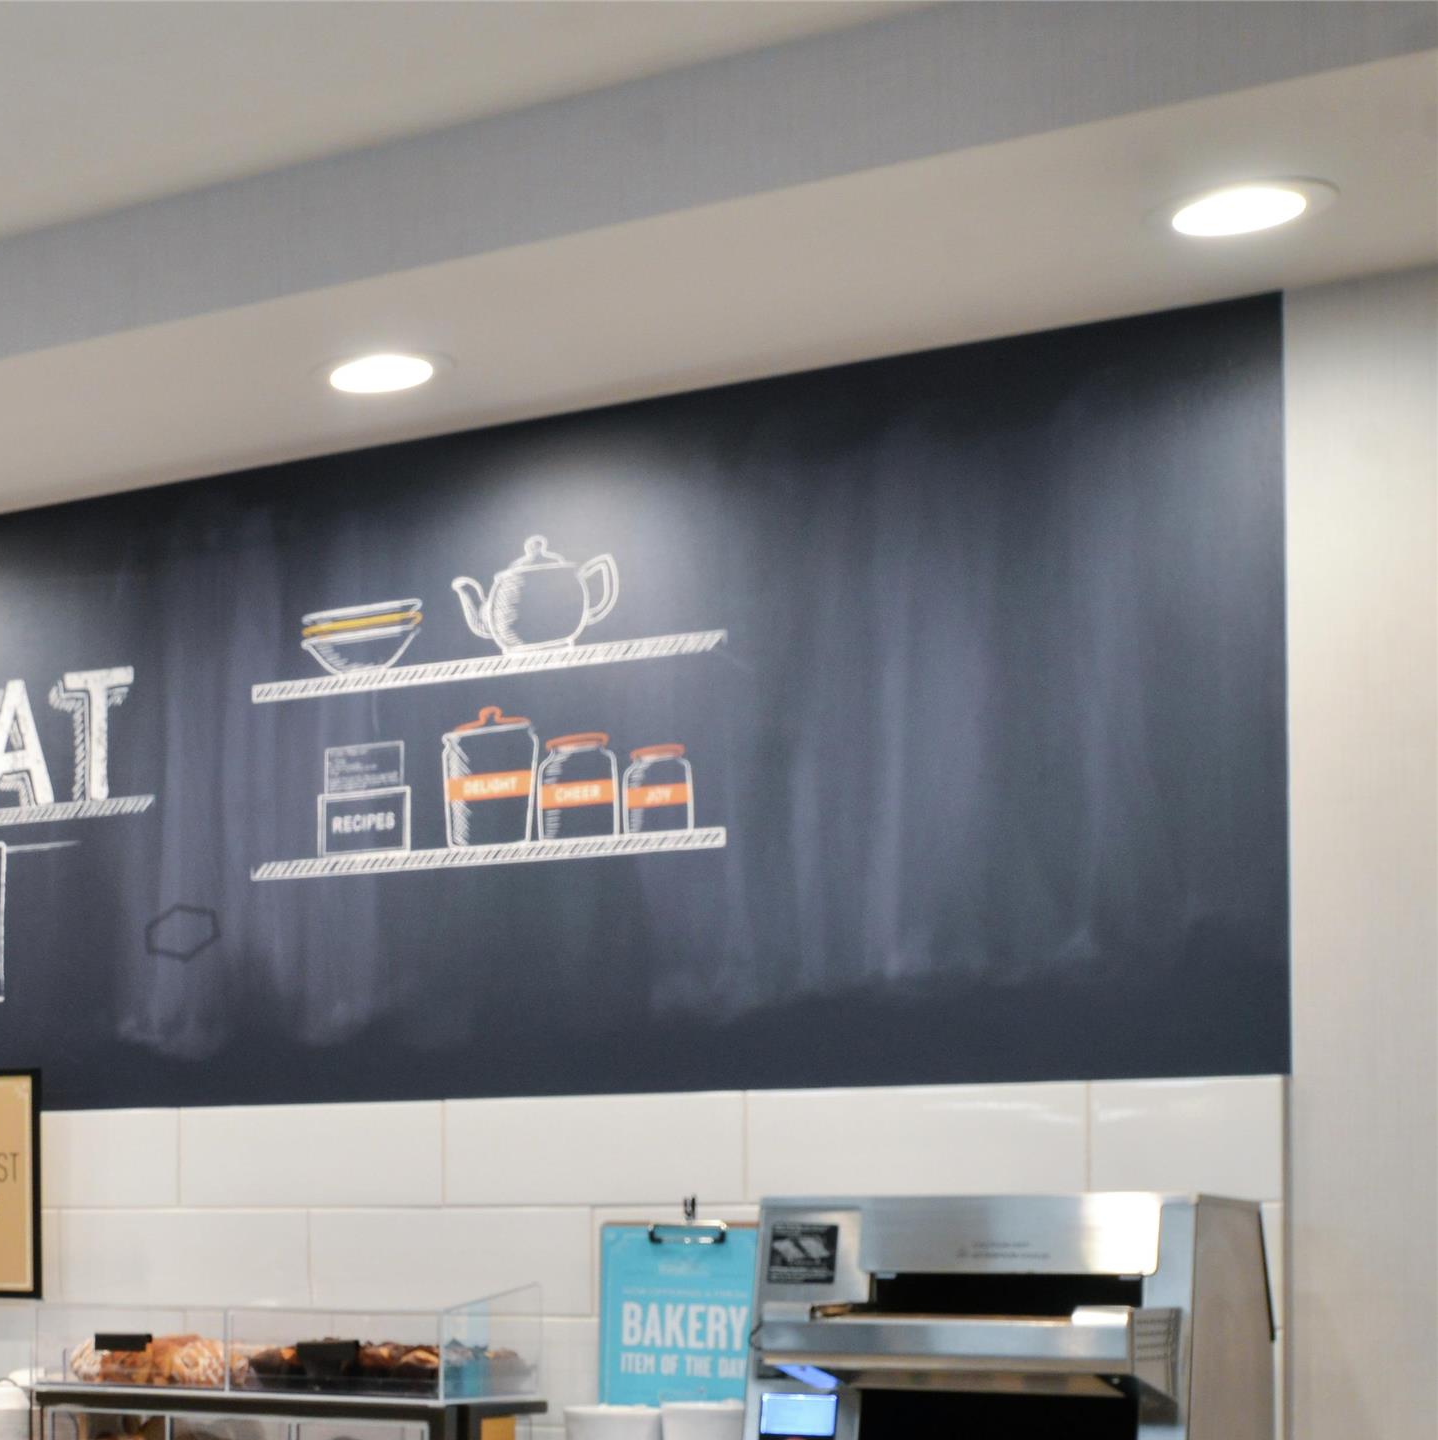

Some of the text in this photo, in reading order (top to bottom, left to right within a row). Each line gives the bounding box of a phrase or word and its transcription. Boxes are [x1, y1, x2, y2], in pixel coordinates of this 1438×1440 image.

[463, 776, 517, 796] DELIGHT
[555, 784, 601, 802] CHEER
[332, 810, 396, 834] RECIPES
[622, 1302, 749, 1351] BAKERY
[660, 1354, 679, 1376] OF
[684, 1355, 712, 1378] THE
